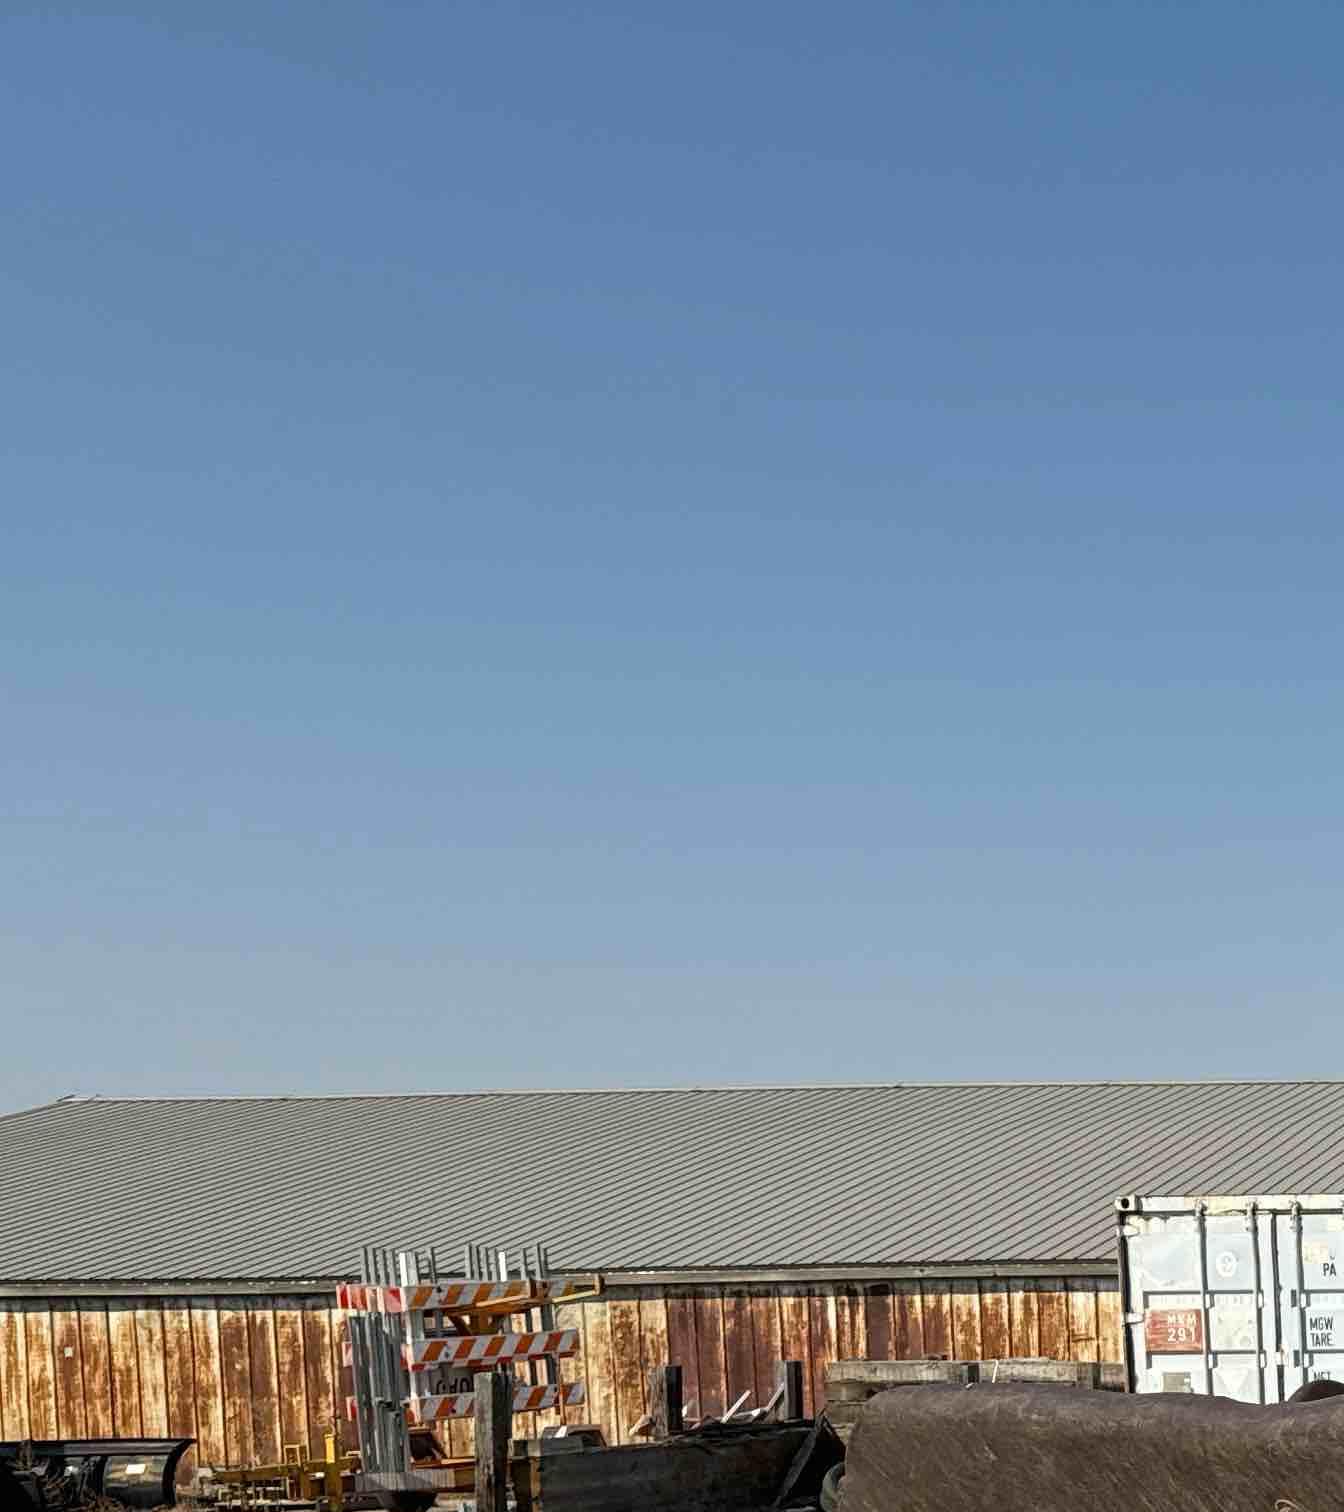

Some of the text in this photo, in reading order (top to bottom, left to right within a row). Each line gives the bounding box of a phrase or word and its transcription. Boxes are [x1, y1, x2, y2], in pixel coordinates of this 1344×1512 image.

[1322, 1263, 1337, 1276] PA
[1309, 1317, 1334, 1331] MGW
[1310, 1332, 1333, 1347] TARE
